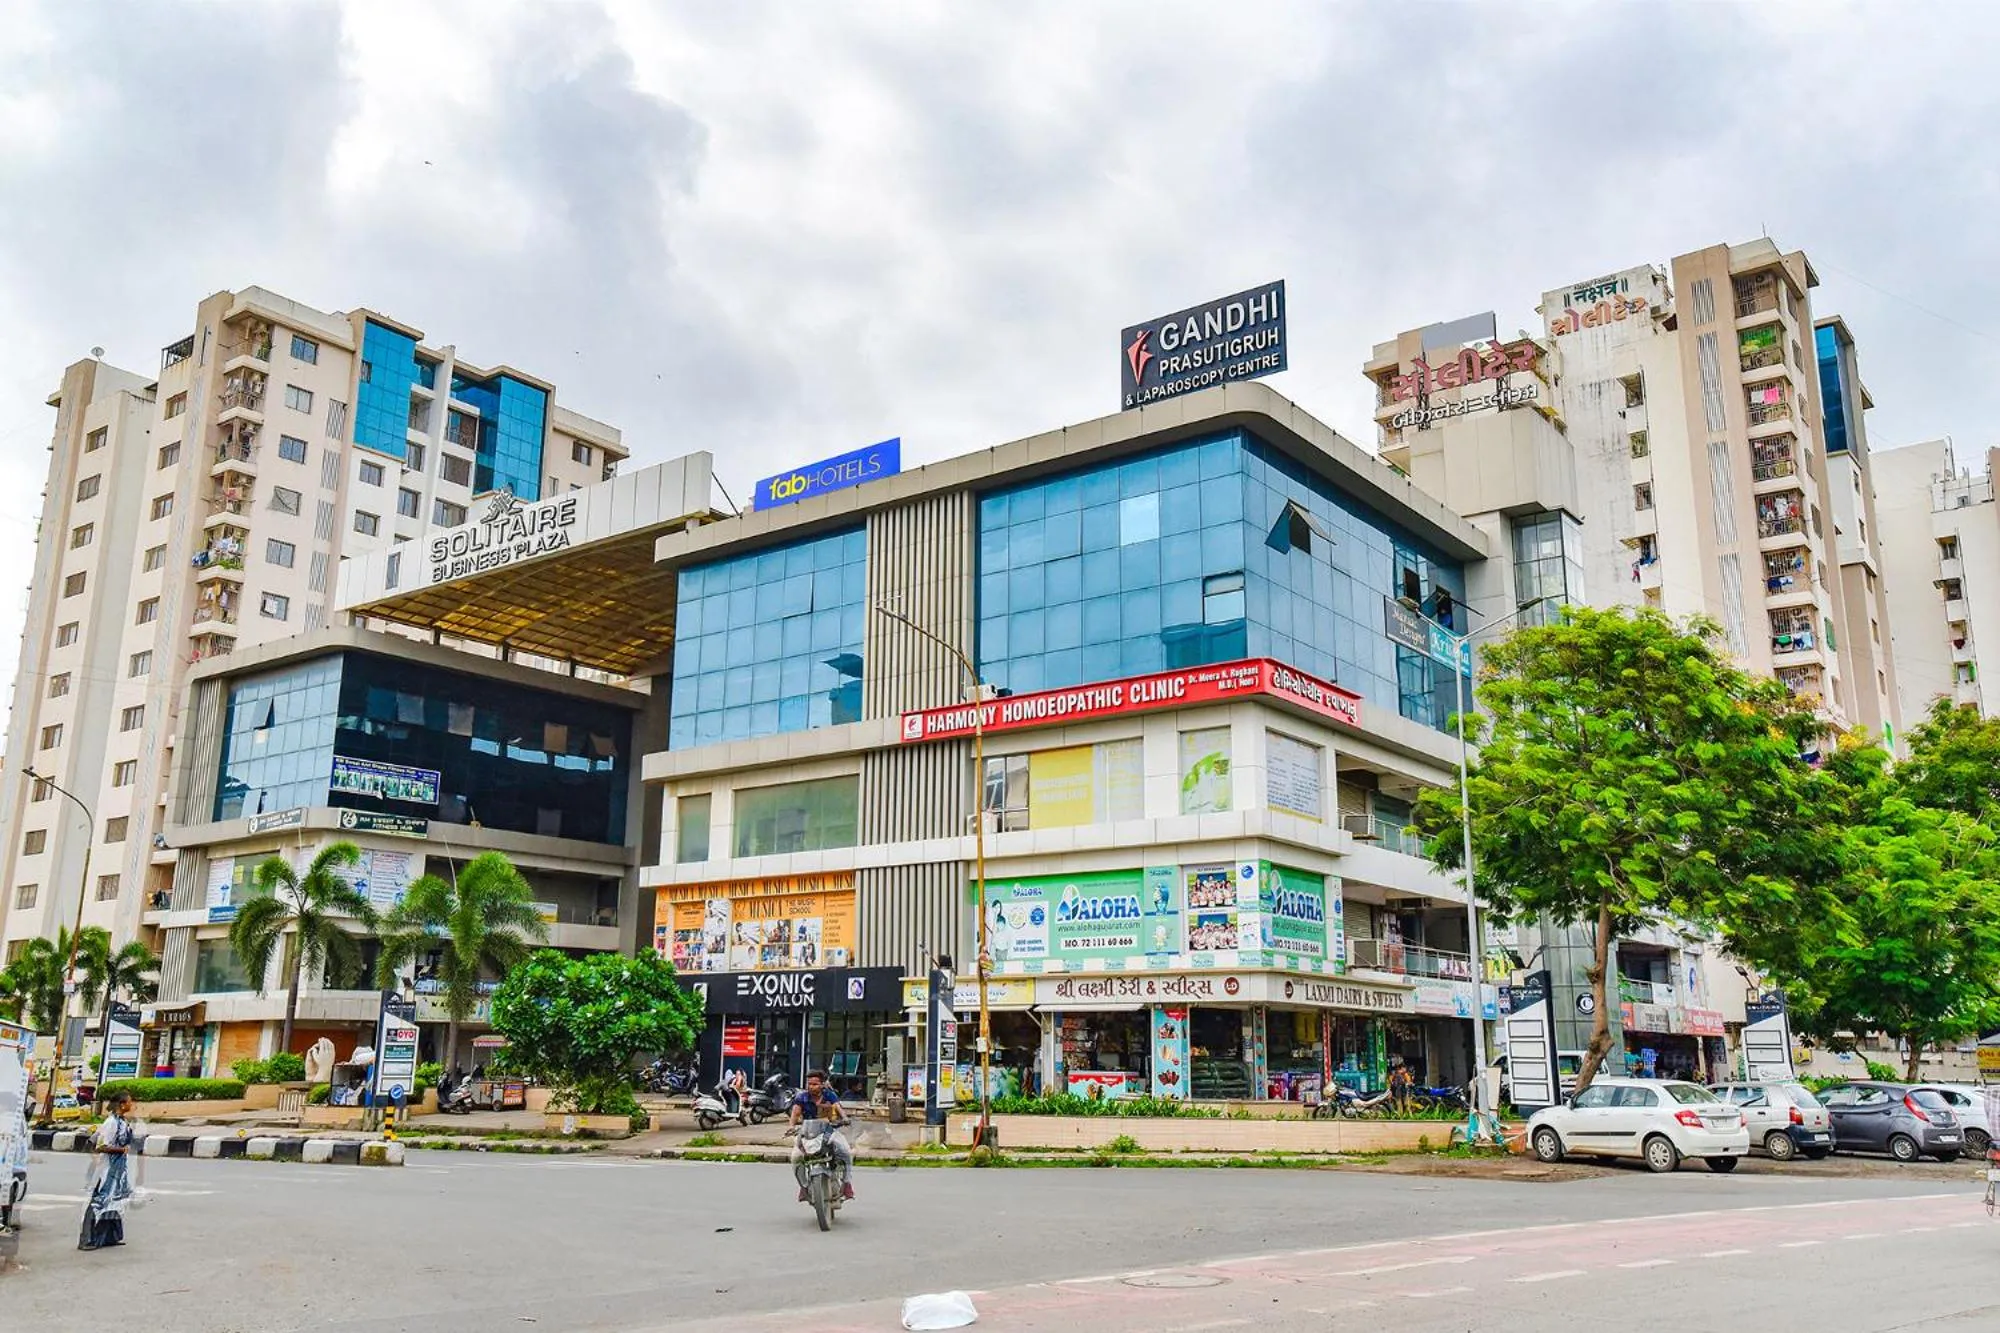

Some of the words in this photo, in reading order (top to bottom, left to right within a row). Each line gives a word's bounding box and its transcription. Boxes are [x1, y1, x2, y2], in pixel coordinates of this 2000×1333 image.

[1159, 290, 1279, 351] GANDHI
[1159, 327, 1280, 378] PRASUTIGRUH
[1125, 393, 1133, 407] &
[1137, 366, 1225, 404] LAPAROSCOPY
[1228, 352, 1280, 378] CENTRE
[430, 497, 577, 564] SOLITAIRE
[432, 544, 512, 583] BUSINESS
[514, 529, 571, 560] PLAZA
[927, 705, 997, 734] HARMONY
[1002, 685, 1123, 723] HOMOEOPATHIC
[1129, 676, 1186, 704] CLINIC
[788, 906, 812, 915] SCHOOL
[1078, 895, 1141, 921] ALOHA
[1281, 889, 1323, 922] ALOHA
[1058, 921, 1141, 933] www.alohagujarat.com
[1081, 939, 1090, 947] 72
[737, 973, 815, 995] EXONIC
[1055, 976, 1075, 998] શ્રી
[1078, 976, 1115, 999] લક્ષ્મી
[1117, 976, 1143, 996] ડેરી
[1146, 977, 1156, 995] &
[1305, 983, 1334, 1004] LAXMI
[1336, 986, 1364, 1006] DAIRY
[1364, 989, 1371, 1007] &
[1373, 991, 1404, 1009] SWEETS
[765, 993, 815, 1008] SALON
[398, 1031, 414, 1039] OYO
